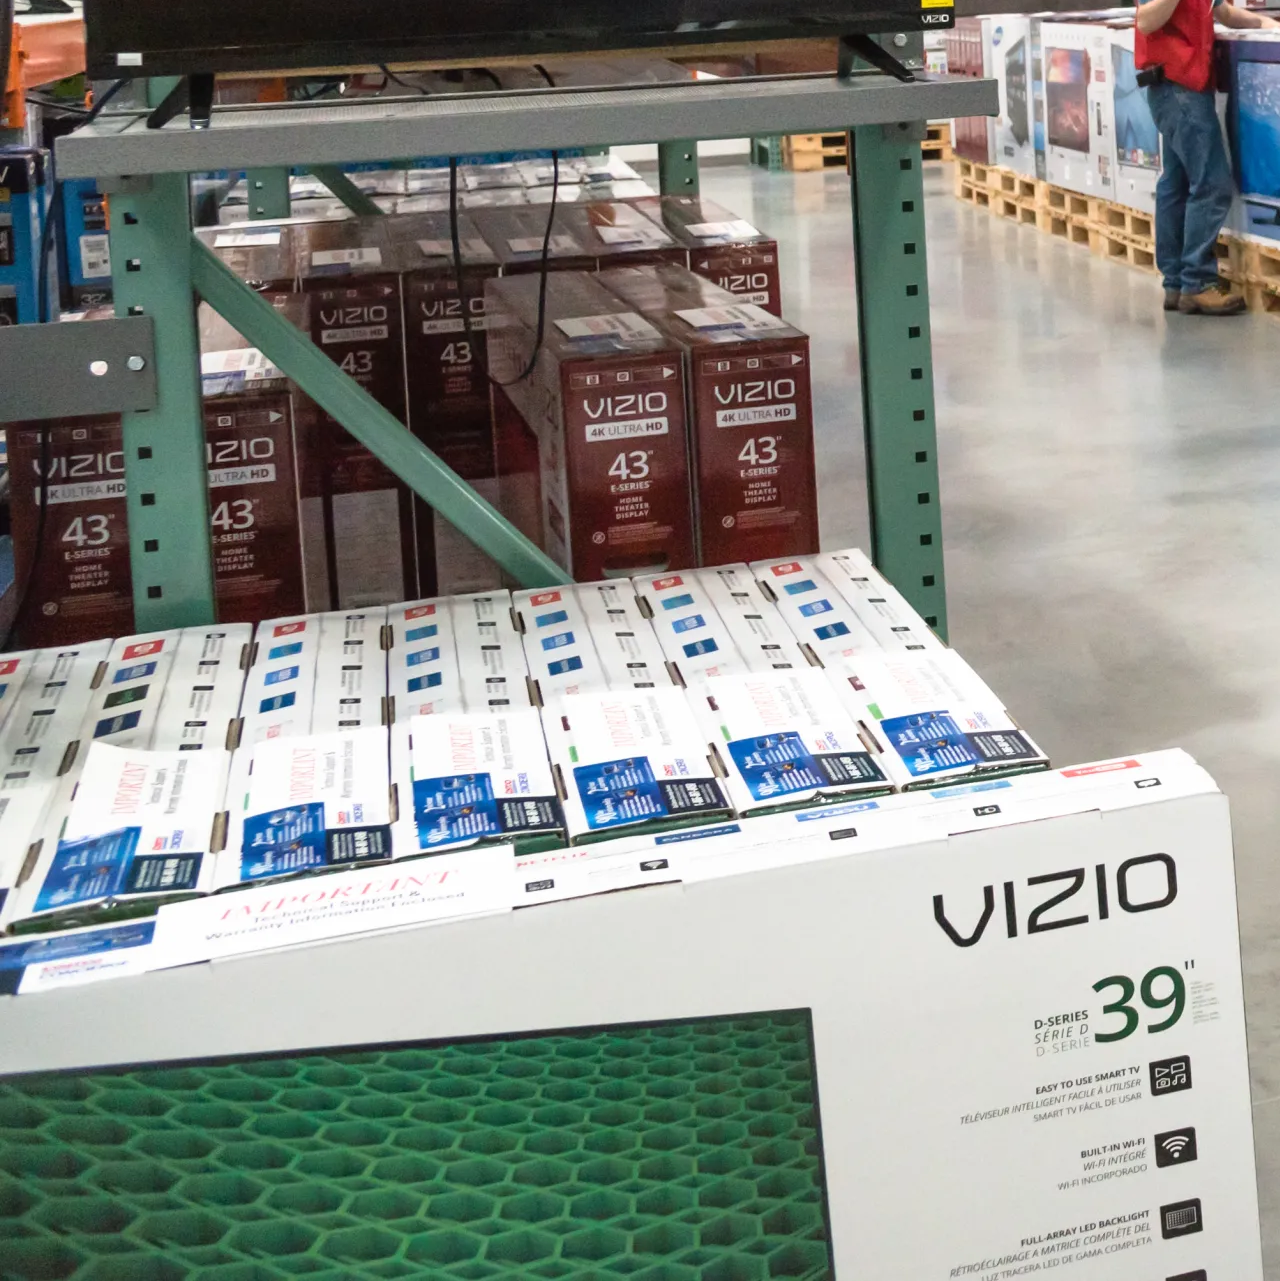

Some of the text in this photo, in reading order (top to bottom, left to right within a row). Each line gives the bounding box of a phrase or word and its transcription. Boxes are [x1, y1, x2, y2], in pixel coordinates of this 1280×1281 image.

[921, 14, 950, 24] VIZIO
[320, 305, 387, 326] VIZIO
[440, 341, 473, 364] 43
[714, 378, 796, 405] VIZIO
[584, 392, 667, 419] VIZIO
[722, 408, 791, 423] 4K ULTRA HD
[591, 421, 663, 438] 4K ULTRA HD
[738, 436, 782, 466] 43"
[608, 450, 653, 480] 43"
[614, 502, 650, 512] THEATER
[615, 510, 650, 520] DISPLAY
[516, 850, 590, 868] NETFLIX
[220, 868, 461, 921] IMPORTANT
[933, 852, 1178, 948] VIZIO
[1092, 959, 1195, 1043] 39"
[1034, 1010, 1089, 1030] D-SERIES
[1034, 1026, 1074, 1045] SÉRIE
[1036, 1036, 1091, 1057] D-SERIE
[1035, 1066, 1141, 1095] EASY TO USE SMART TV
[960, 1079, 1142, 1125] TÉLÉVISEUR INTELLIGENT FACILE UTILISER
[1080, 1137, 1146, 1159] BUILT-IN WI-FI
[1083, 1148, 1147, 1171] WI-FI INTÉGRÉ
[1081, 1164, 1148, 1185] INCORPORADO
[1020, 1210, 1150, 1247] FULL-ARRAY LED BACKLIGHT
